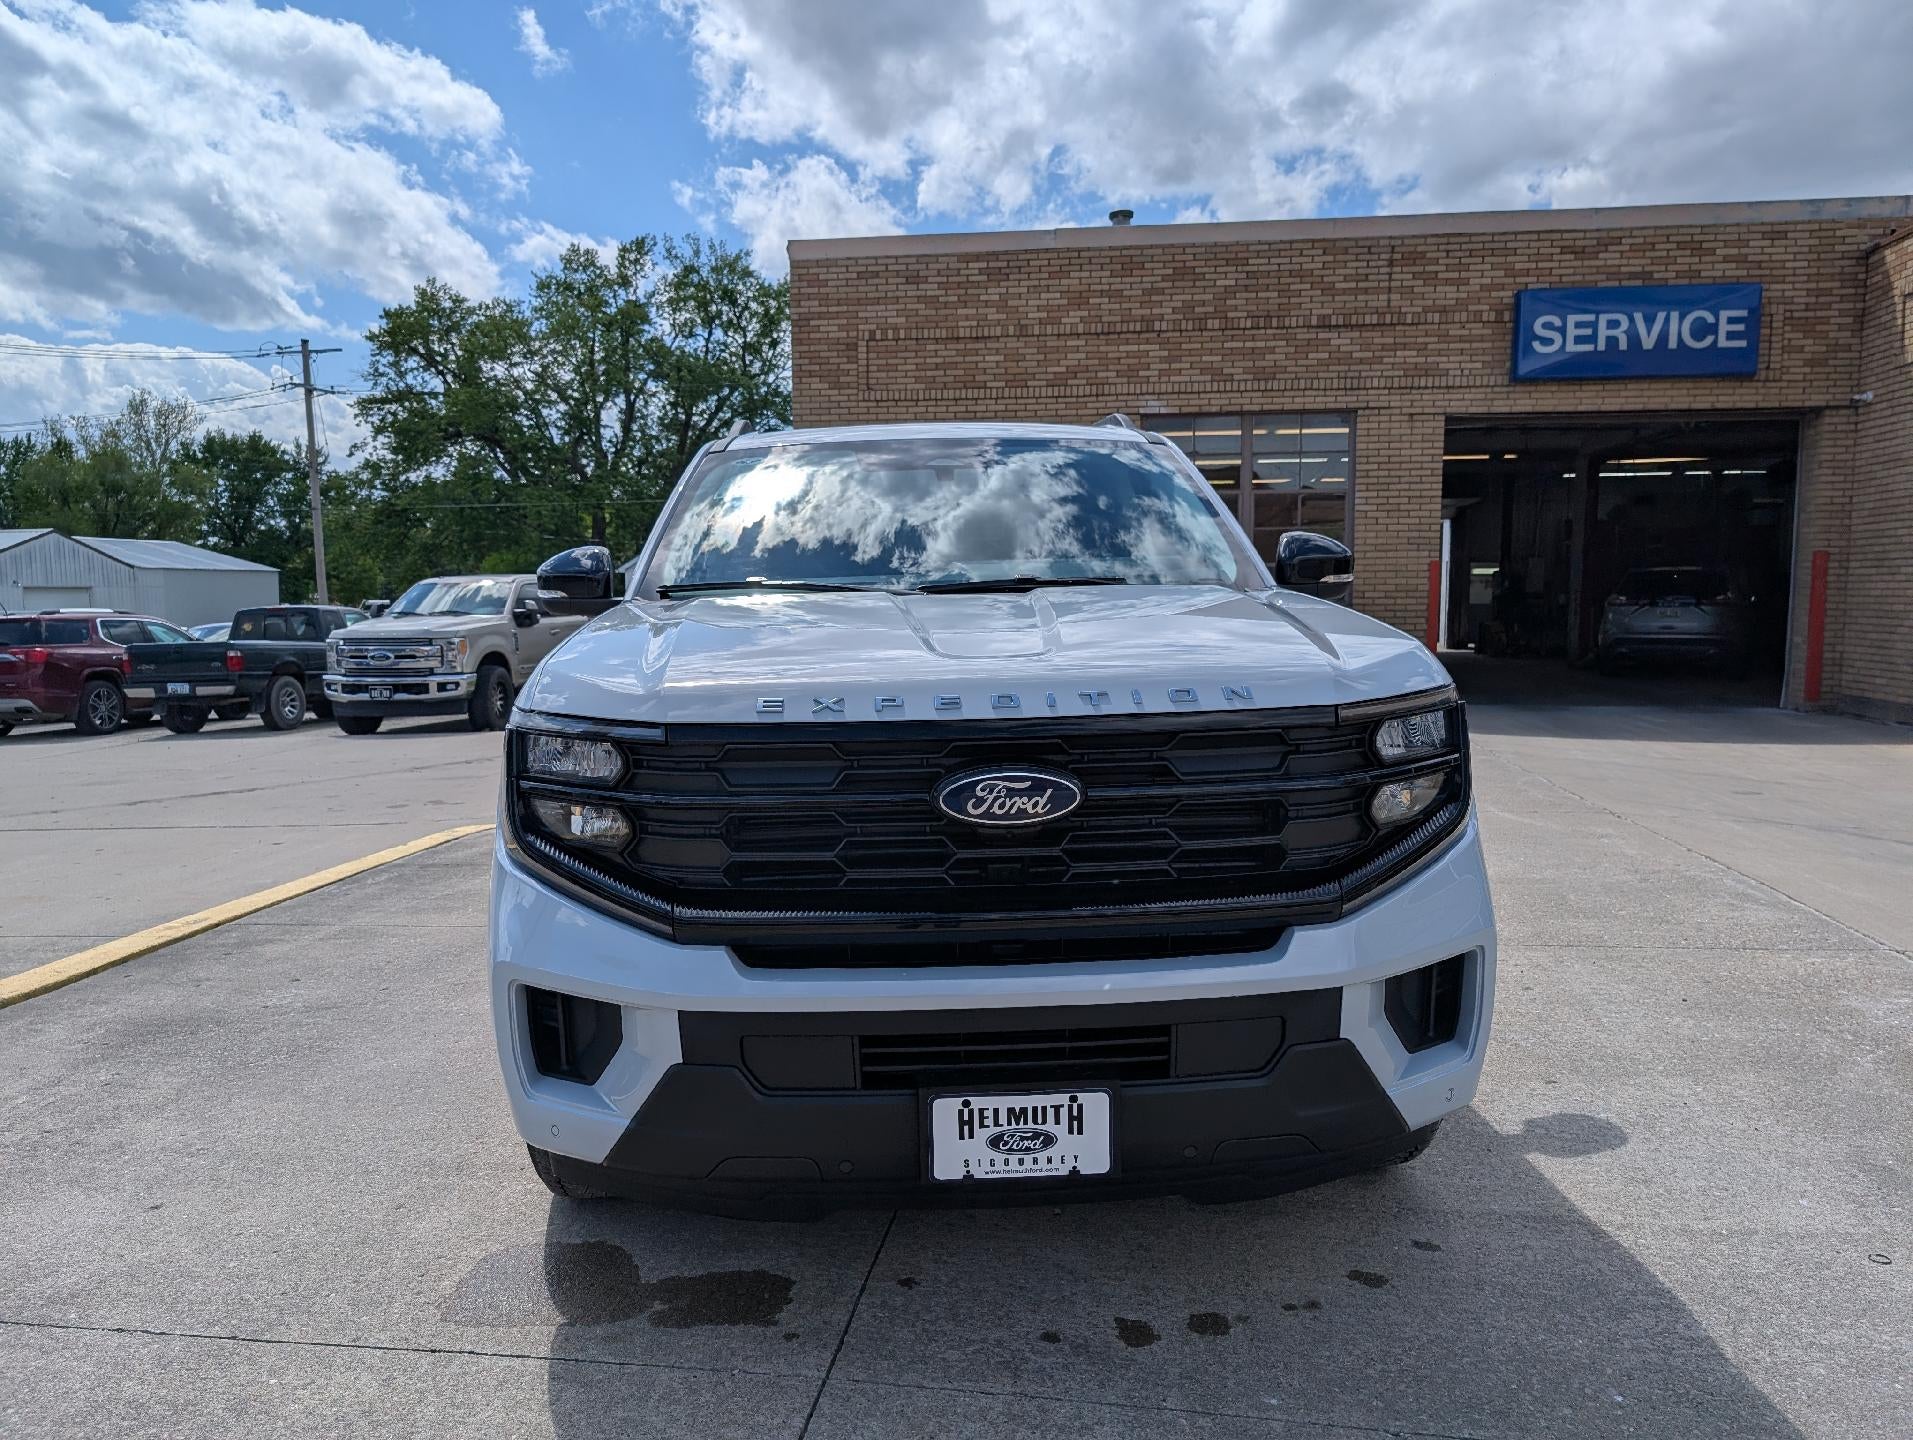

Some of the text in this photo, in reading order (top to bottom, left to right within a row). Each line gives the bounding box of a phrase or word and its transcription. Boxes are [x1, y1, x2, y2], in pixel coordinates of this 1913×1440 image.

[1531, 309, 1749, 354] SERVICE
[756, 685, 1254, 714] EXPEDITION
[966, 780, 1054, 816] Ford
[957, 1101, 1084, 1141] HELMUTH
[999, 1132, 1044, 1151] Ford
[963, 1154, 1079, 1169] SIGOURNEY
